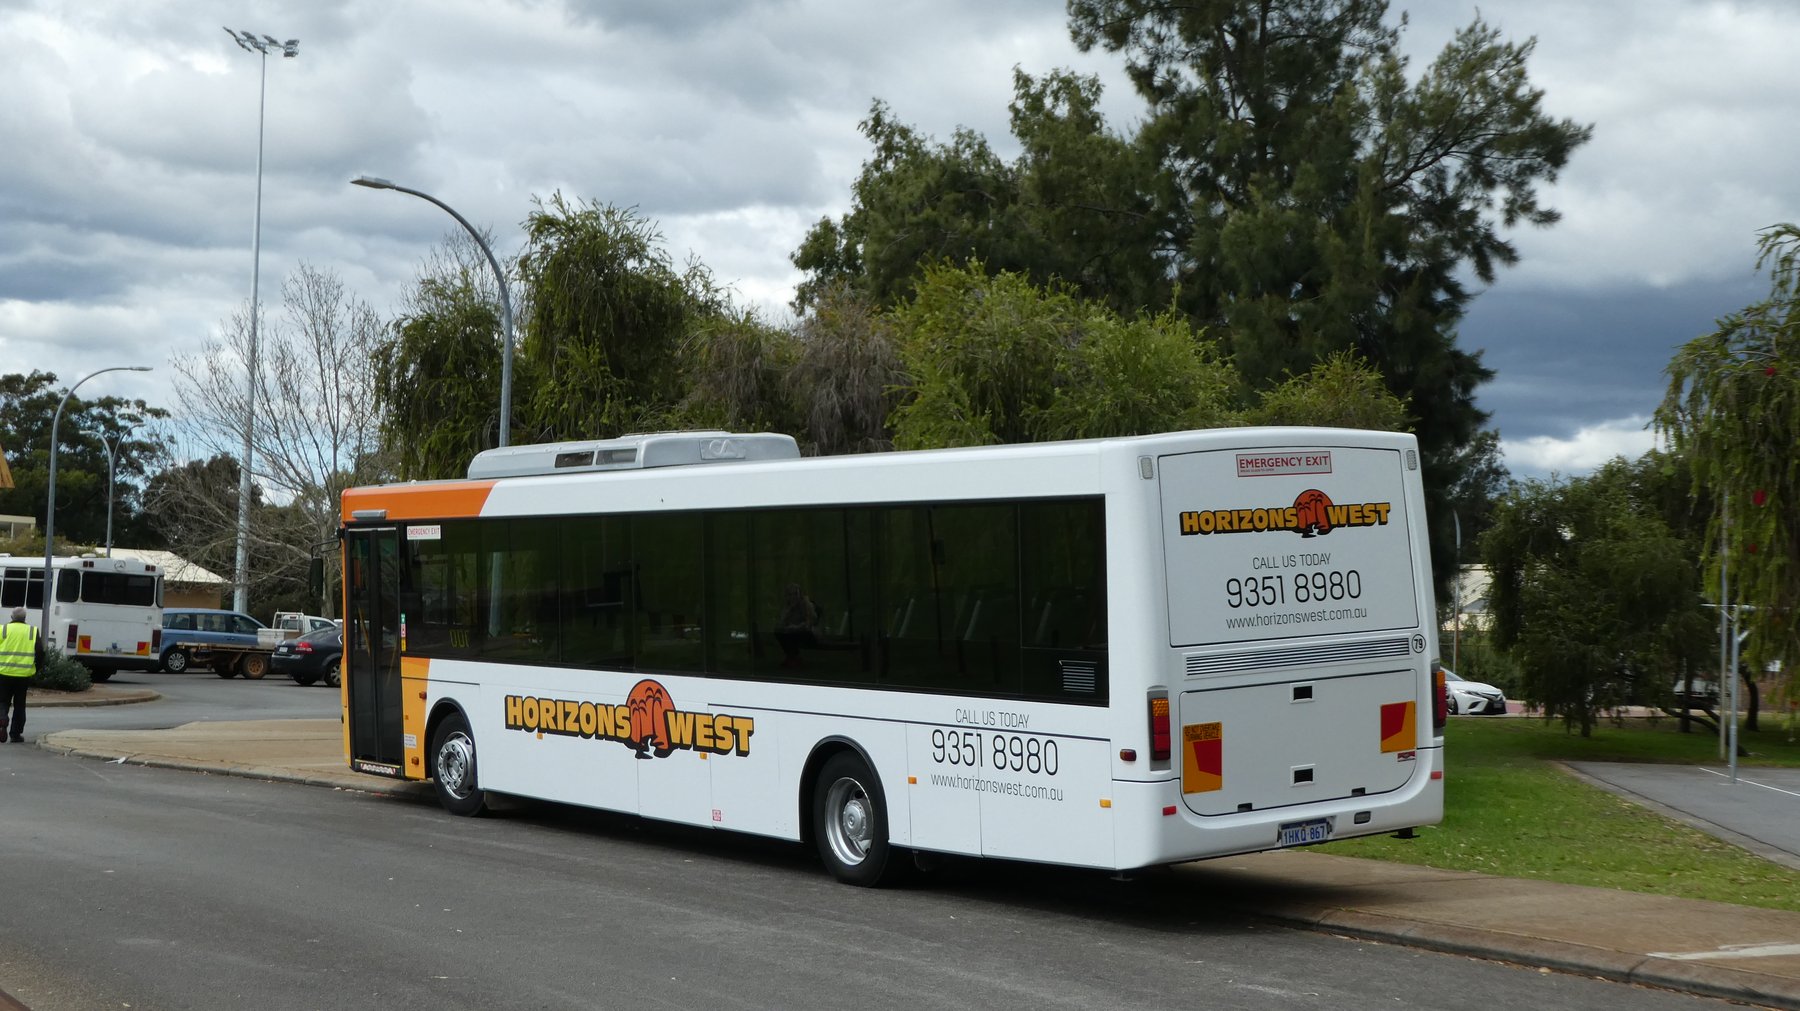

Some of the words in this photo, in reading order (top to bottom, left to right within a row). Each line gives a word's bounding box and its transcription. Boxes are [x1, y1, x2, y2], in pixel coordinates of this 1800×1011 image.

[1239, 457, 1302, 469] EMERGENCY
[1305, 455, 1329, 466] EXIT
[1180, 507, 1299, 536] HORIZONS
[1326, 502, 1391, 528] WEST
[1252, 556, 1280, 570] CALL
[1282, 554, 1297, 568] US
[1299, 552, 1331, 567] TODAY
[1226, 575, 1285, 608] 9351
[1294, 569, 1362, 603] 8980
[1225, 607, 1368, 629] www.horizonswest.com.au
[1413, 638, 1424, 650] 79
[505, 695, 633, 740] HORIZONS
[664, 709, 755, 757] WEST
[955, 708, 980, 724] CALL
[982, 710, 996, 726] US
[998, 711, 1030, 729] TODAY
[932, 729, 983, 768] 9351
[993, 734, 1059, 776] 8980
[930, 773, 1064, 801] www.horizonswest.com.au
